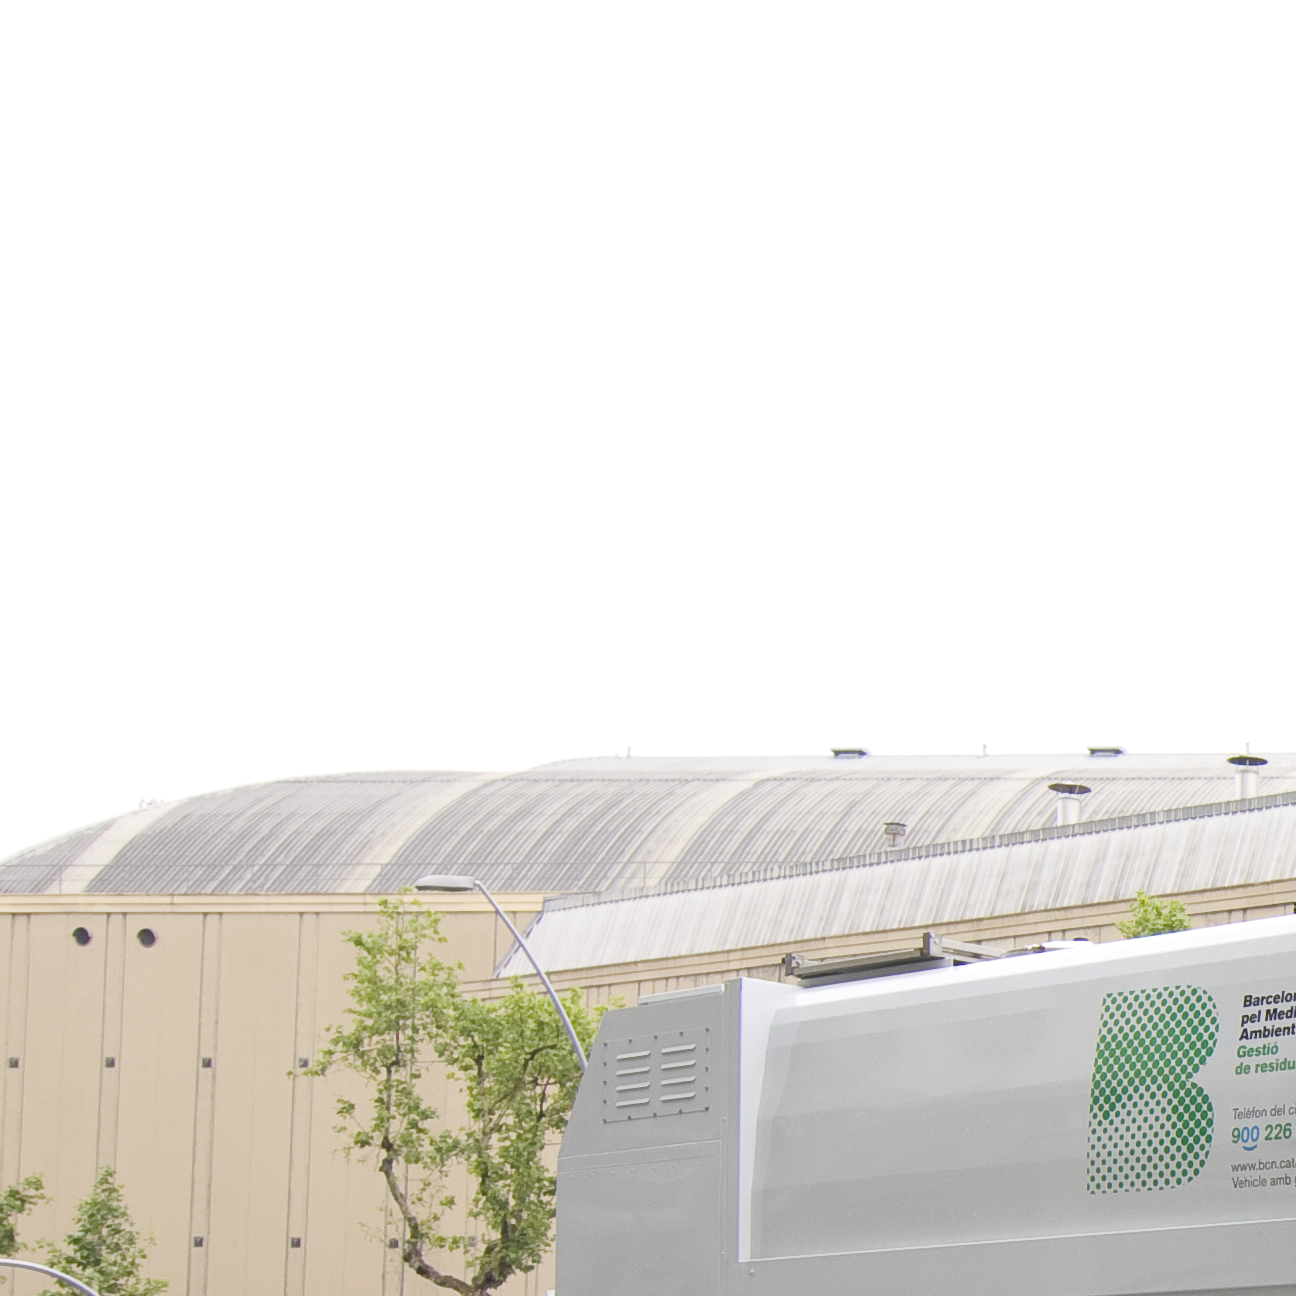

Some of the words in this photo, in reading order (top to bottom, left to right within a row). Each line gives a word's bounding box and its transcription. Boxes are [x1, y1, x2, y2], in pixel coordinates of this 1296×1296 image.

[1240, 1009, 1262, 1027] pel
[1239, 1023, 1296, 1041] Ambient
[1236, 1041, 1279, 1059] Gestió
[1234, 1062, 1251, 1075] de
[1270, 1103, 1286, 1117] del
[1231, 1125, 1260, 1144] 900
[1264, 1122, 1293, 1141] 226
[1231, 1175, 1268, 1189] Vehicle
[1269, 1173, 1292, 1187] amb
